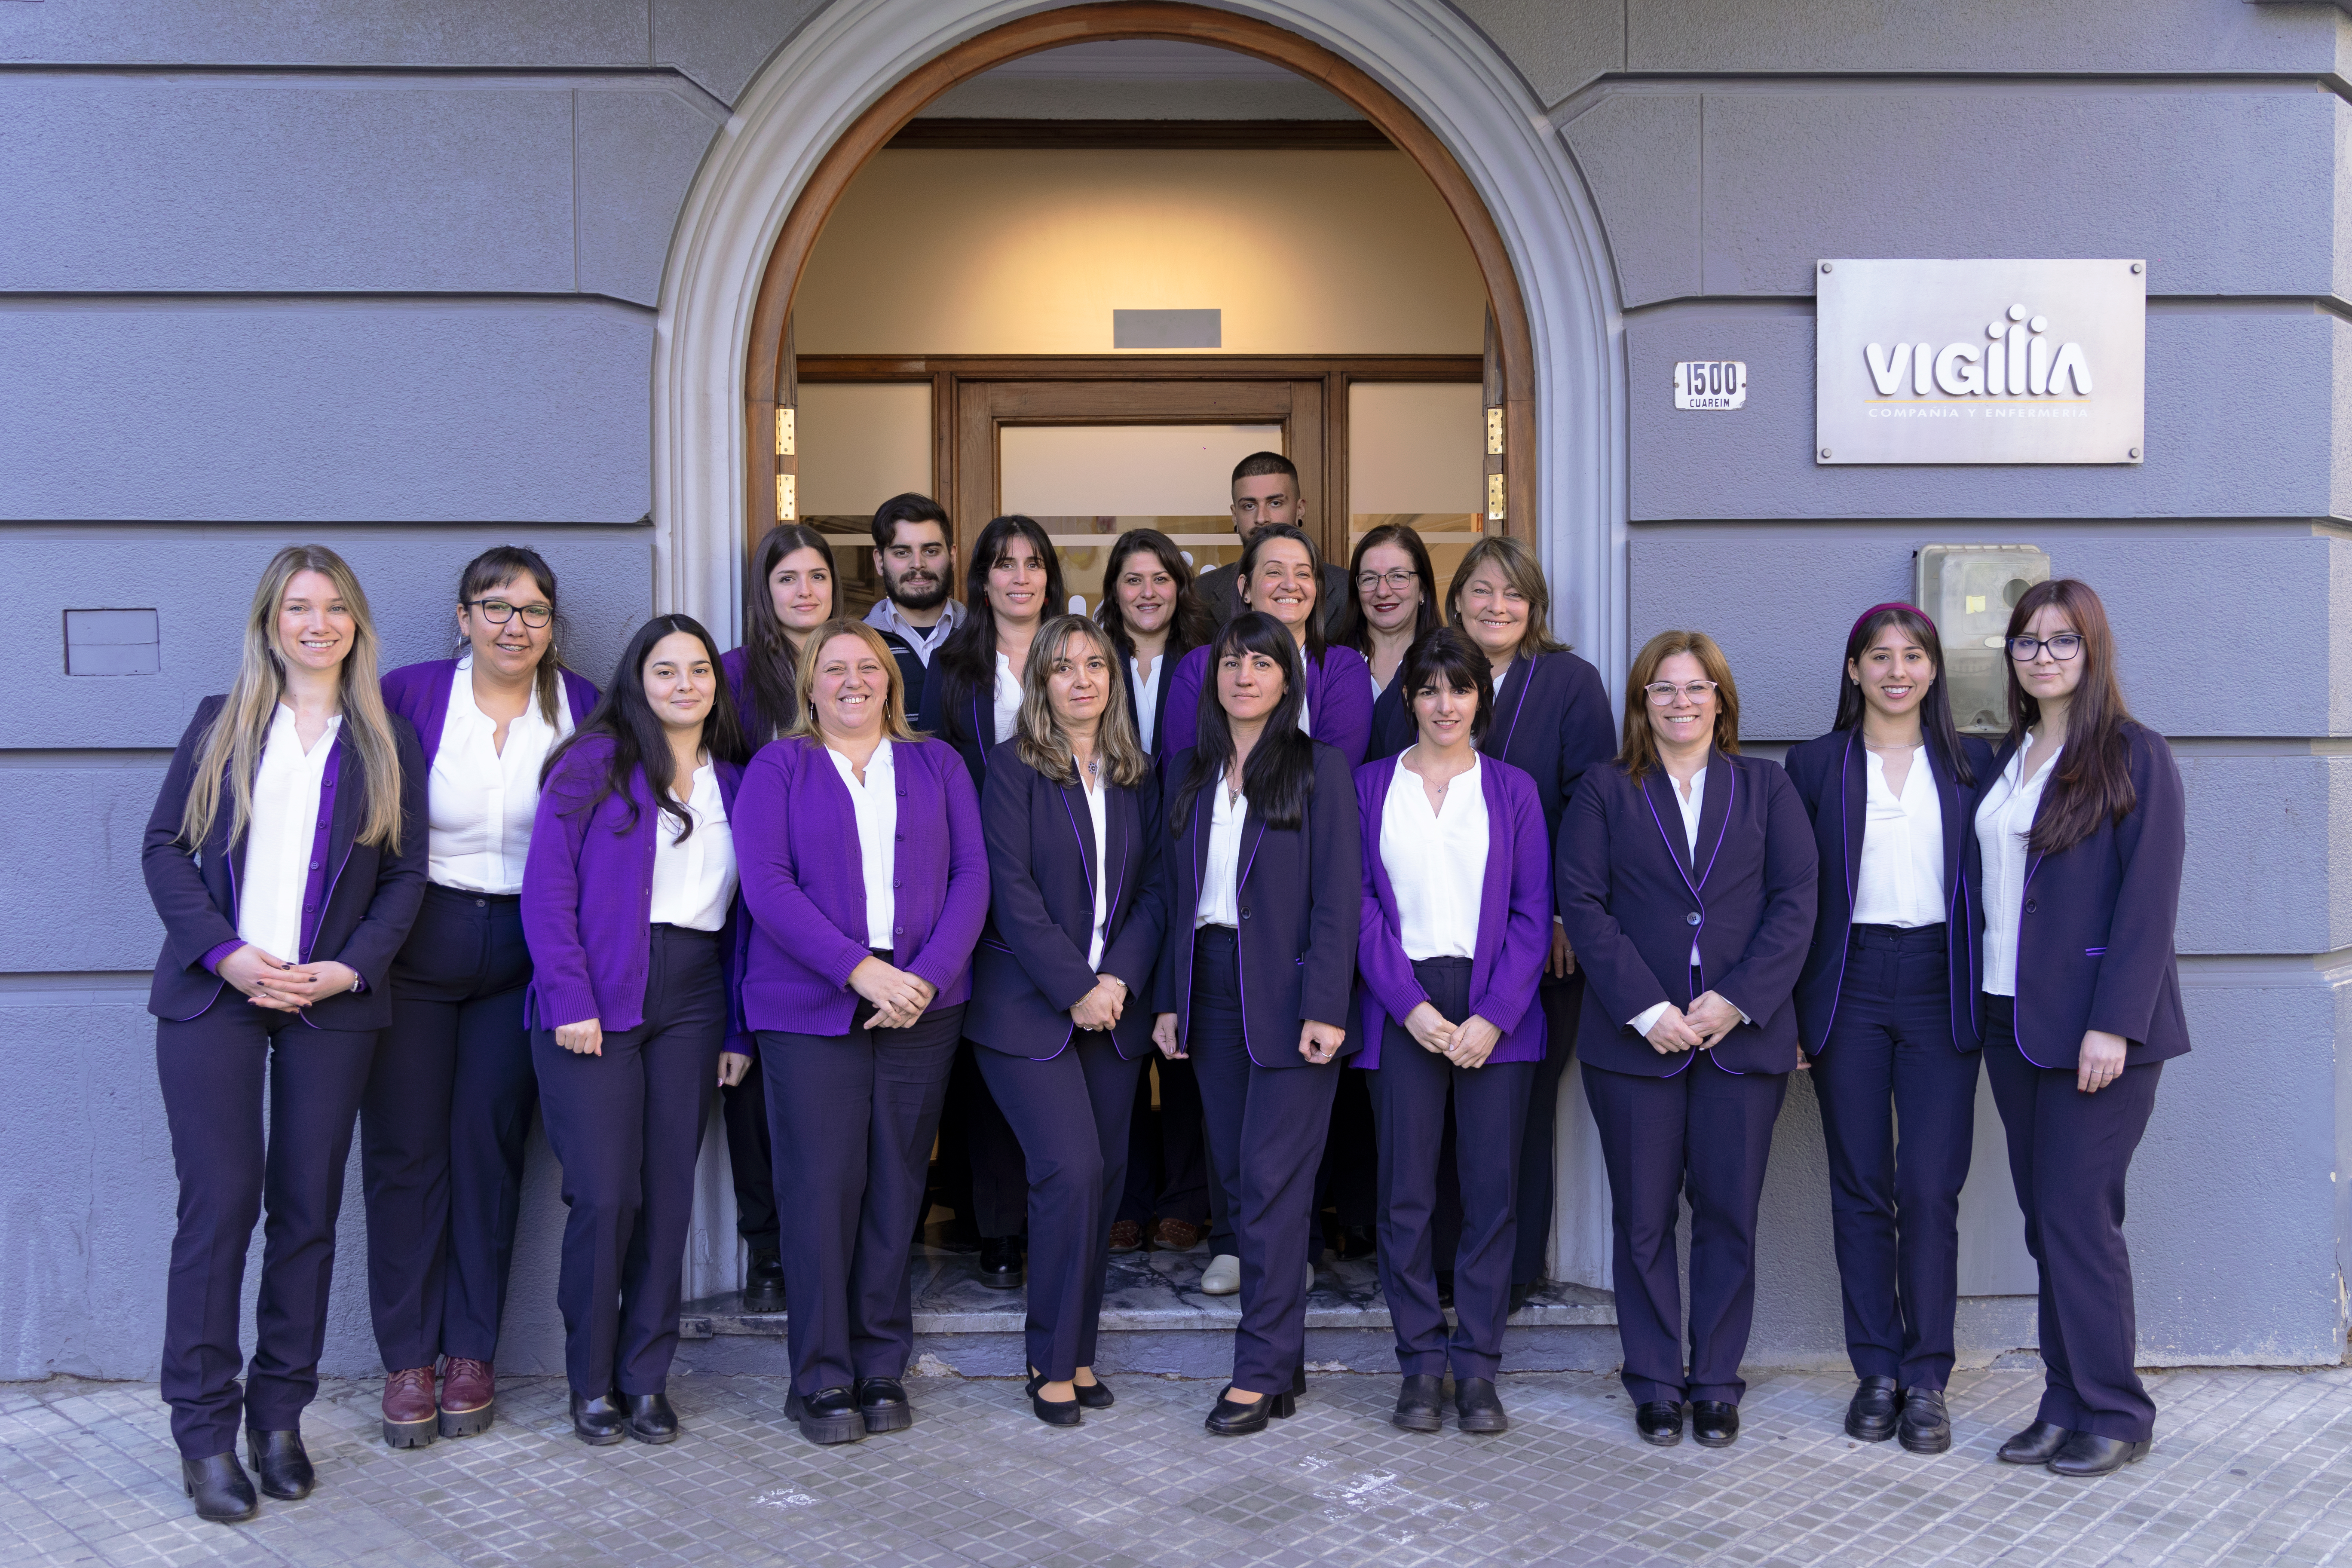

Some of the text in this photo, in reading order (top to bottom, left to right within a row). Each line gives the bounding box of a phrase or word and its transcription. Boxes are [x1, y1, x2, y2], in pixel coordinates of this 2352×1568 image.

[1686, 363, 1736, 395] 1500
[1690, 398, 1730, 407] CUAREIM
[1868, 405, 2088, 418] COMPAÑÍA Y ENFERMERÍA
